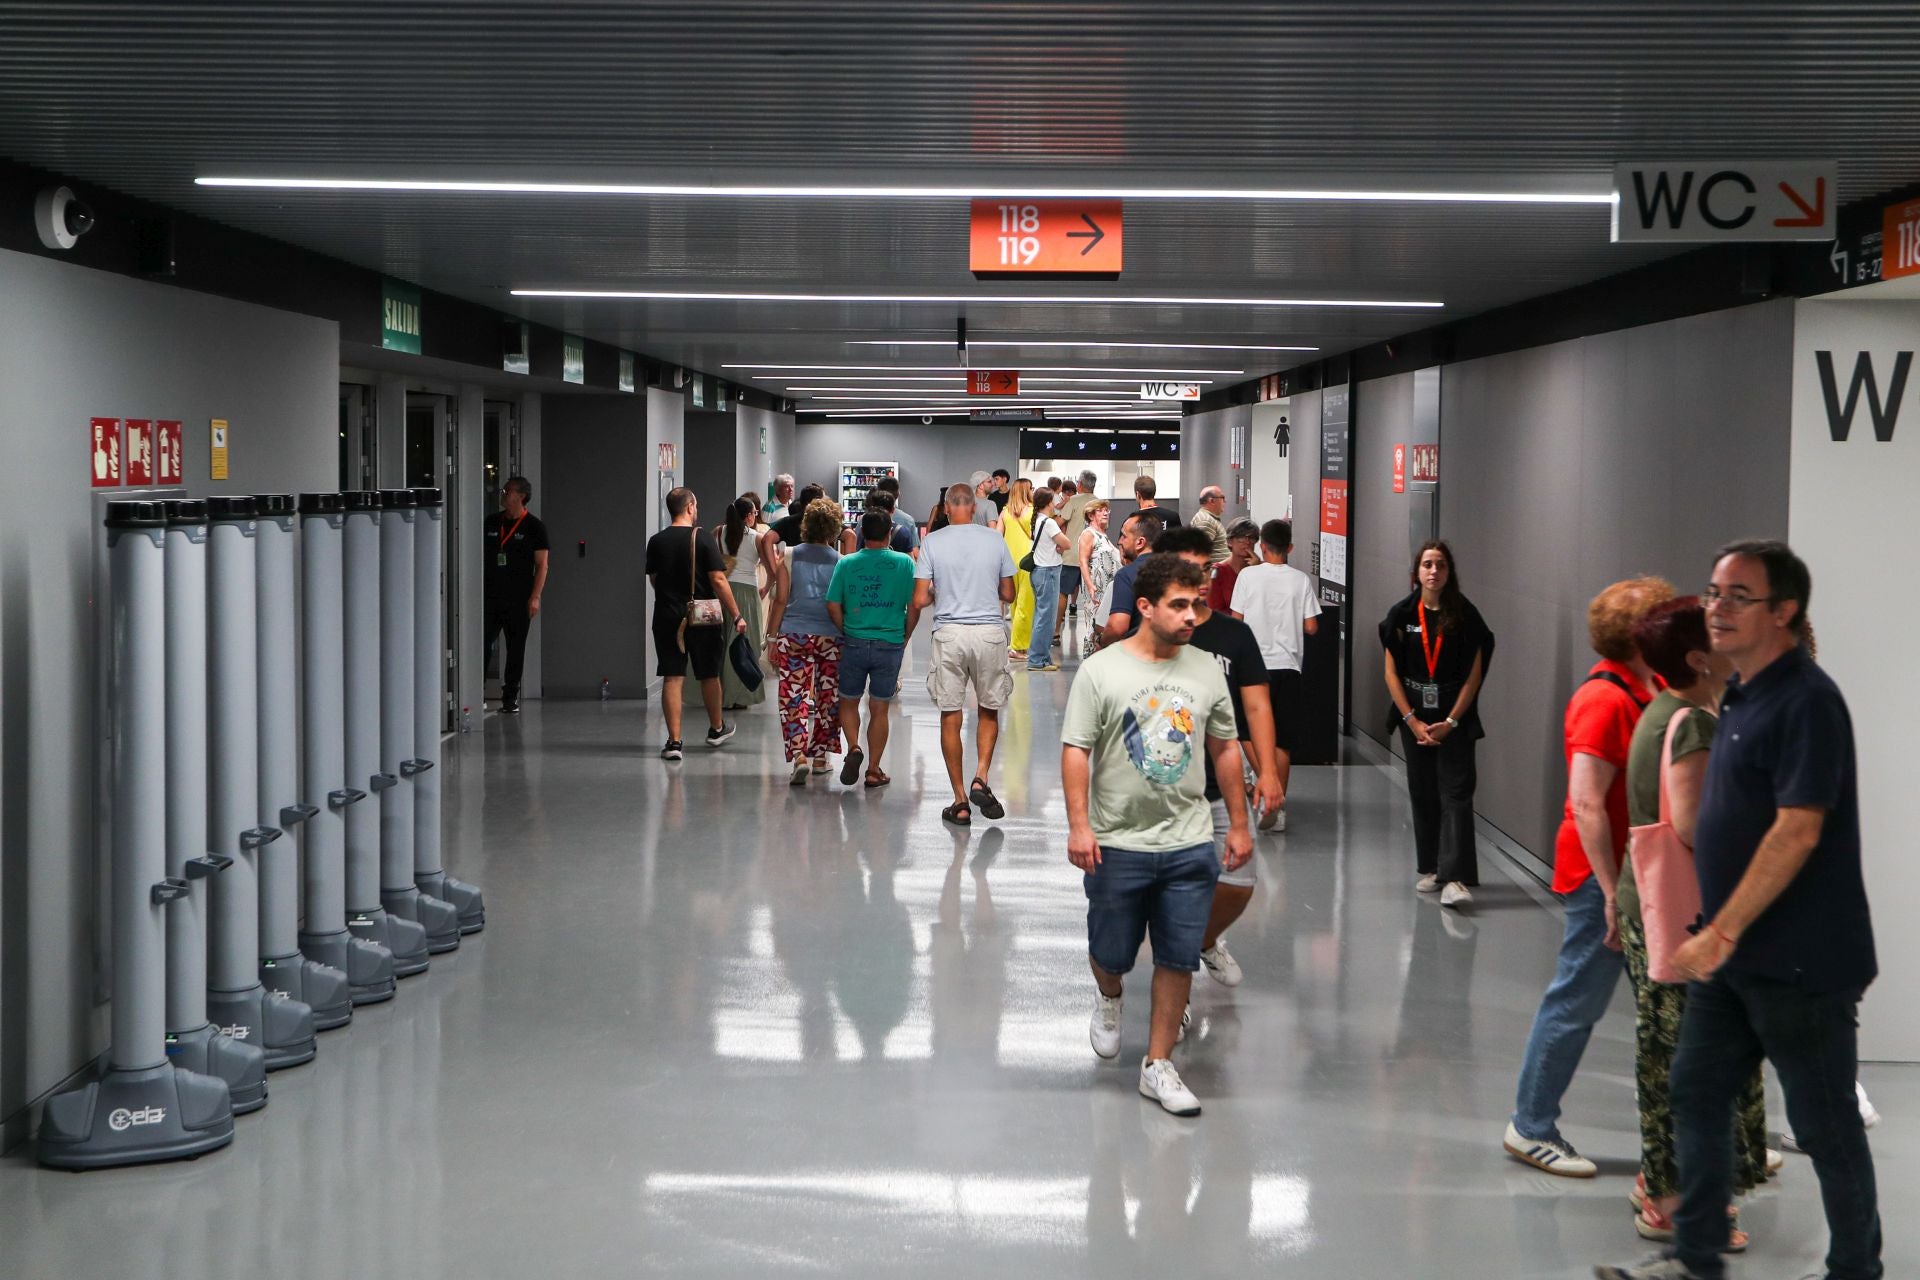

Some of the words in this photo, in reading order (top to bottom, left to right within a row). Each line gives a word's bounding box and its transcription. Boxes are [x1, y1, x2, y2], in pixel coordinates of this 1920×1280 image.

[1632, 170, 1757, 230] WC
[998, 205, 1040, 233] 118
[998, 236, 1040, 265] 119
[385, 298, 419, 336] SALIDA
[976, 371, 990, 382] 117
[976, 382, 991, 393] 118
[1145, 382, 1179, 397] WC
[1814, 350, 1915, 442] W
[863, 583, 882, 592] OFF
[1131, 687, 1150, 703] SURF
[1153, 684, 1195, 703] VACATION
